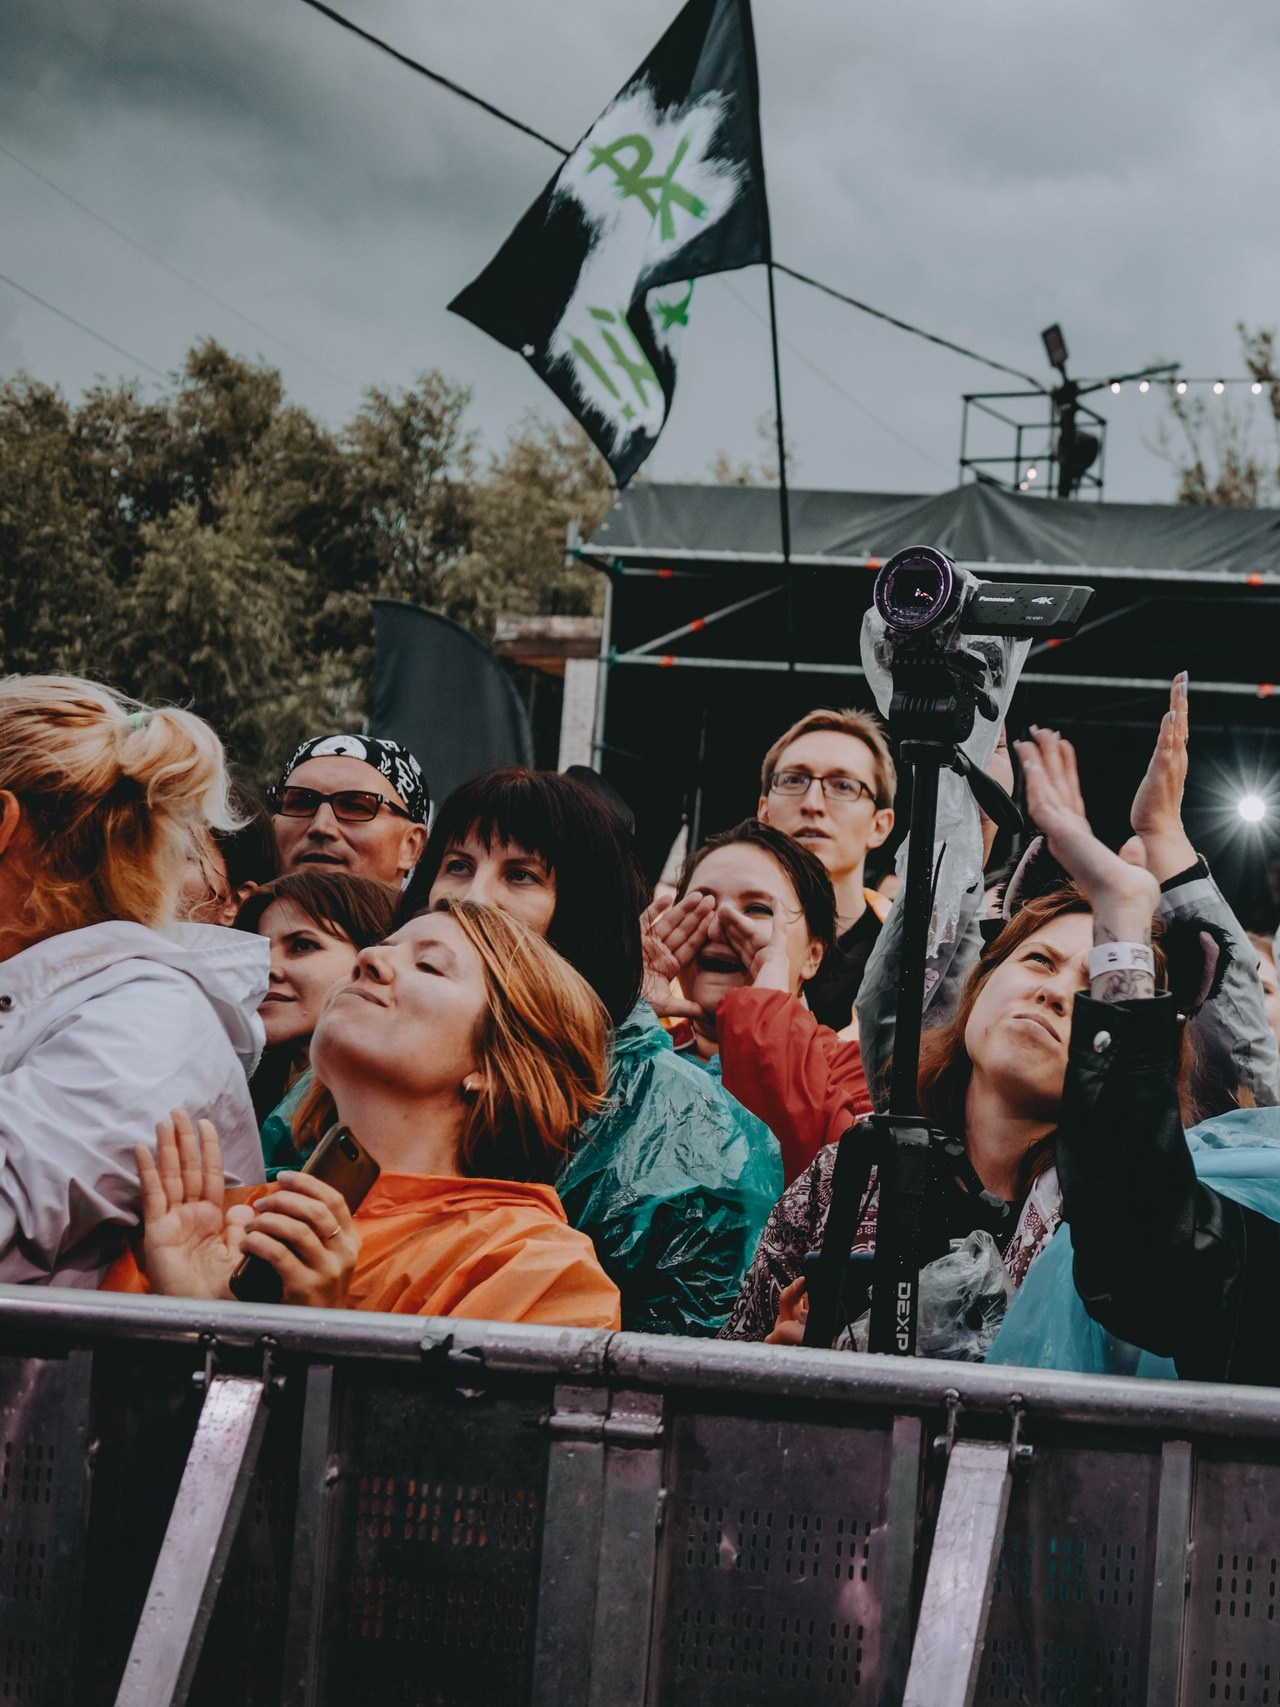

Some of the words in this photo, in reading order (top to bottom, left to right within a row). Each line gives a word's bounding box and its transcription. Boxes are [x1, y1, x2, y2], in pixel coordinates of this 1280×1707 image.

[978, 595, 1016, 603] Panasonic
[1031, 596, 1055, 605] 4K
[895, 1281, 912, 1351] DEXP
